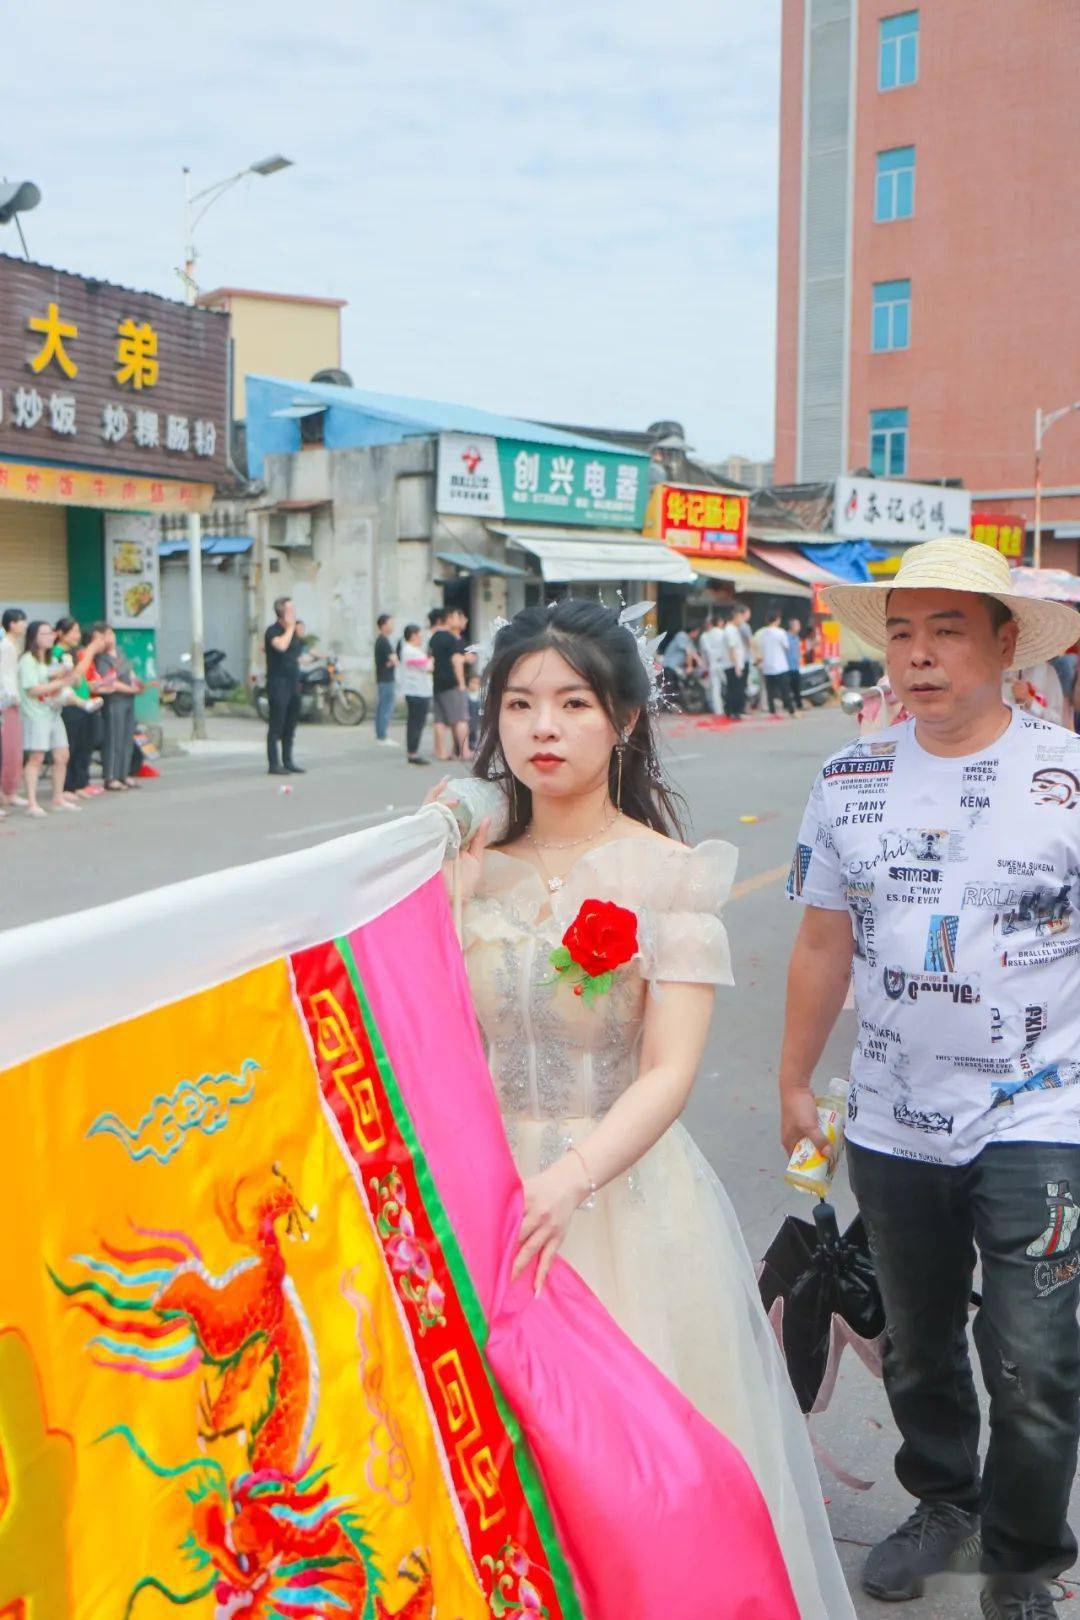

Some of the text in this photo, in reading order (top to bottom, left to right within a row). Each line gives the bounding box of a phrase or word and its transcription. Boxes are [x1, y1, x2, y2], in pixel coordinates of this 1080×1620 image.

[28, 302, 160, 390] 大弟
[0, 386, 77, 435] 炒饭
[960, 795, 992, 808] KENA
[852, 813, 883, 824] EVEN
[997, 859, 1055, 873] SUKENA SUKENA
[896, 867, 944, 882] SIMPLE
[917, 896, 940, 905] EVEN
